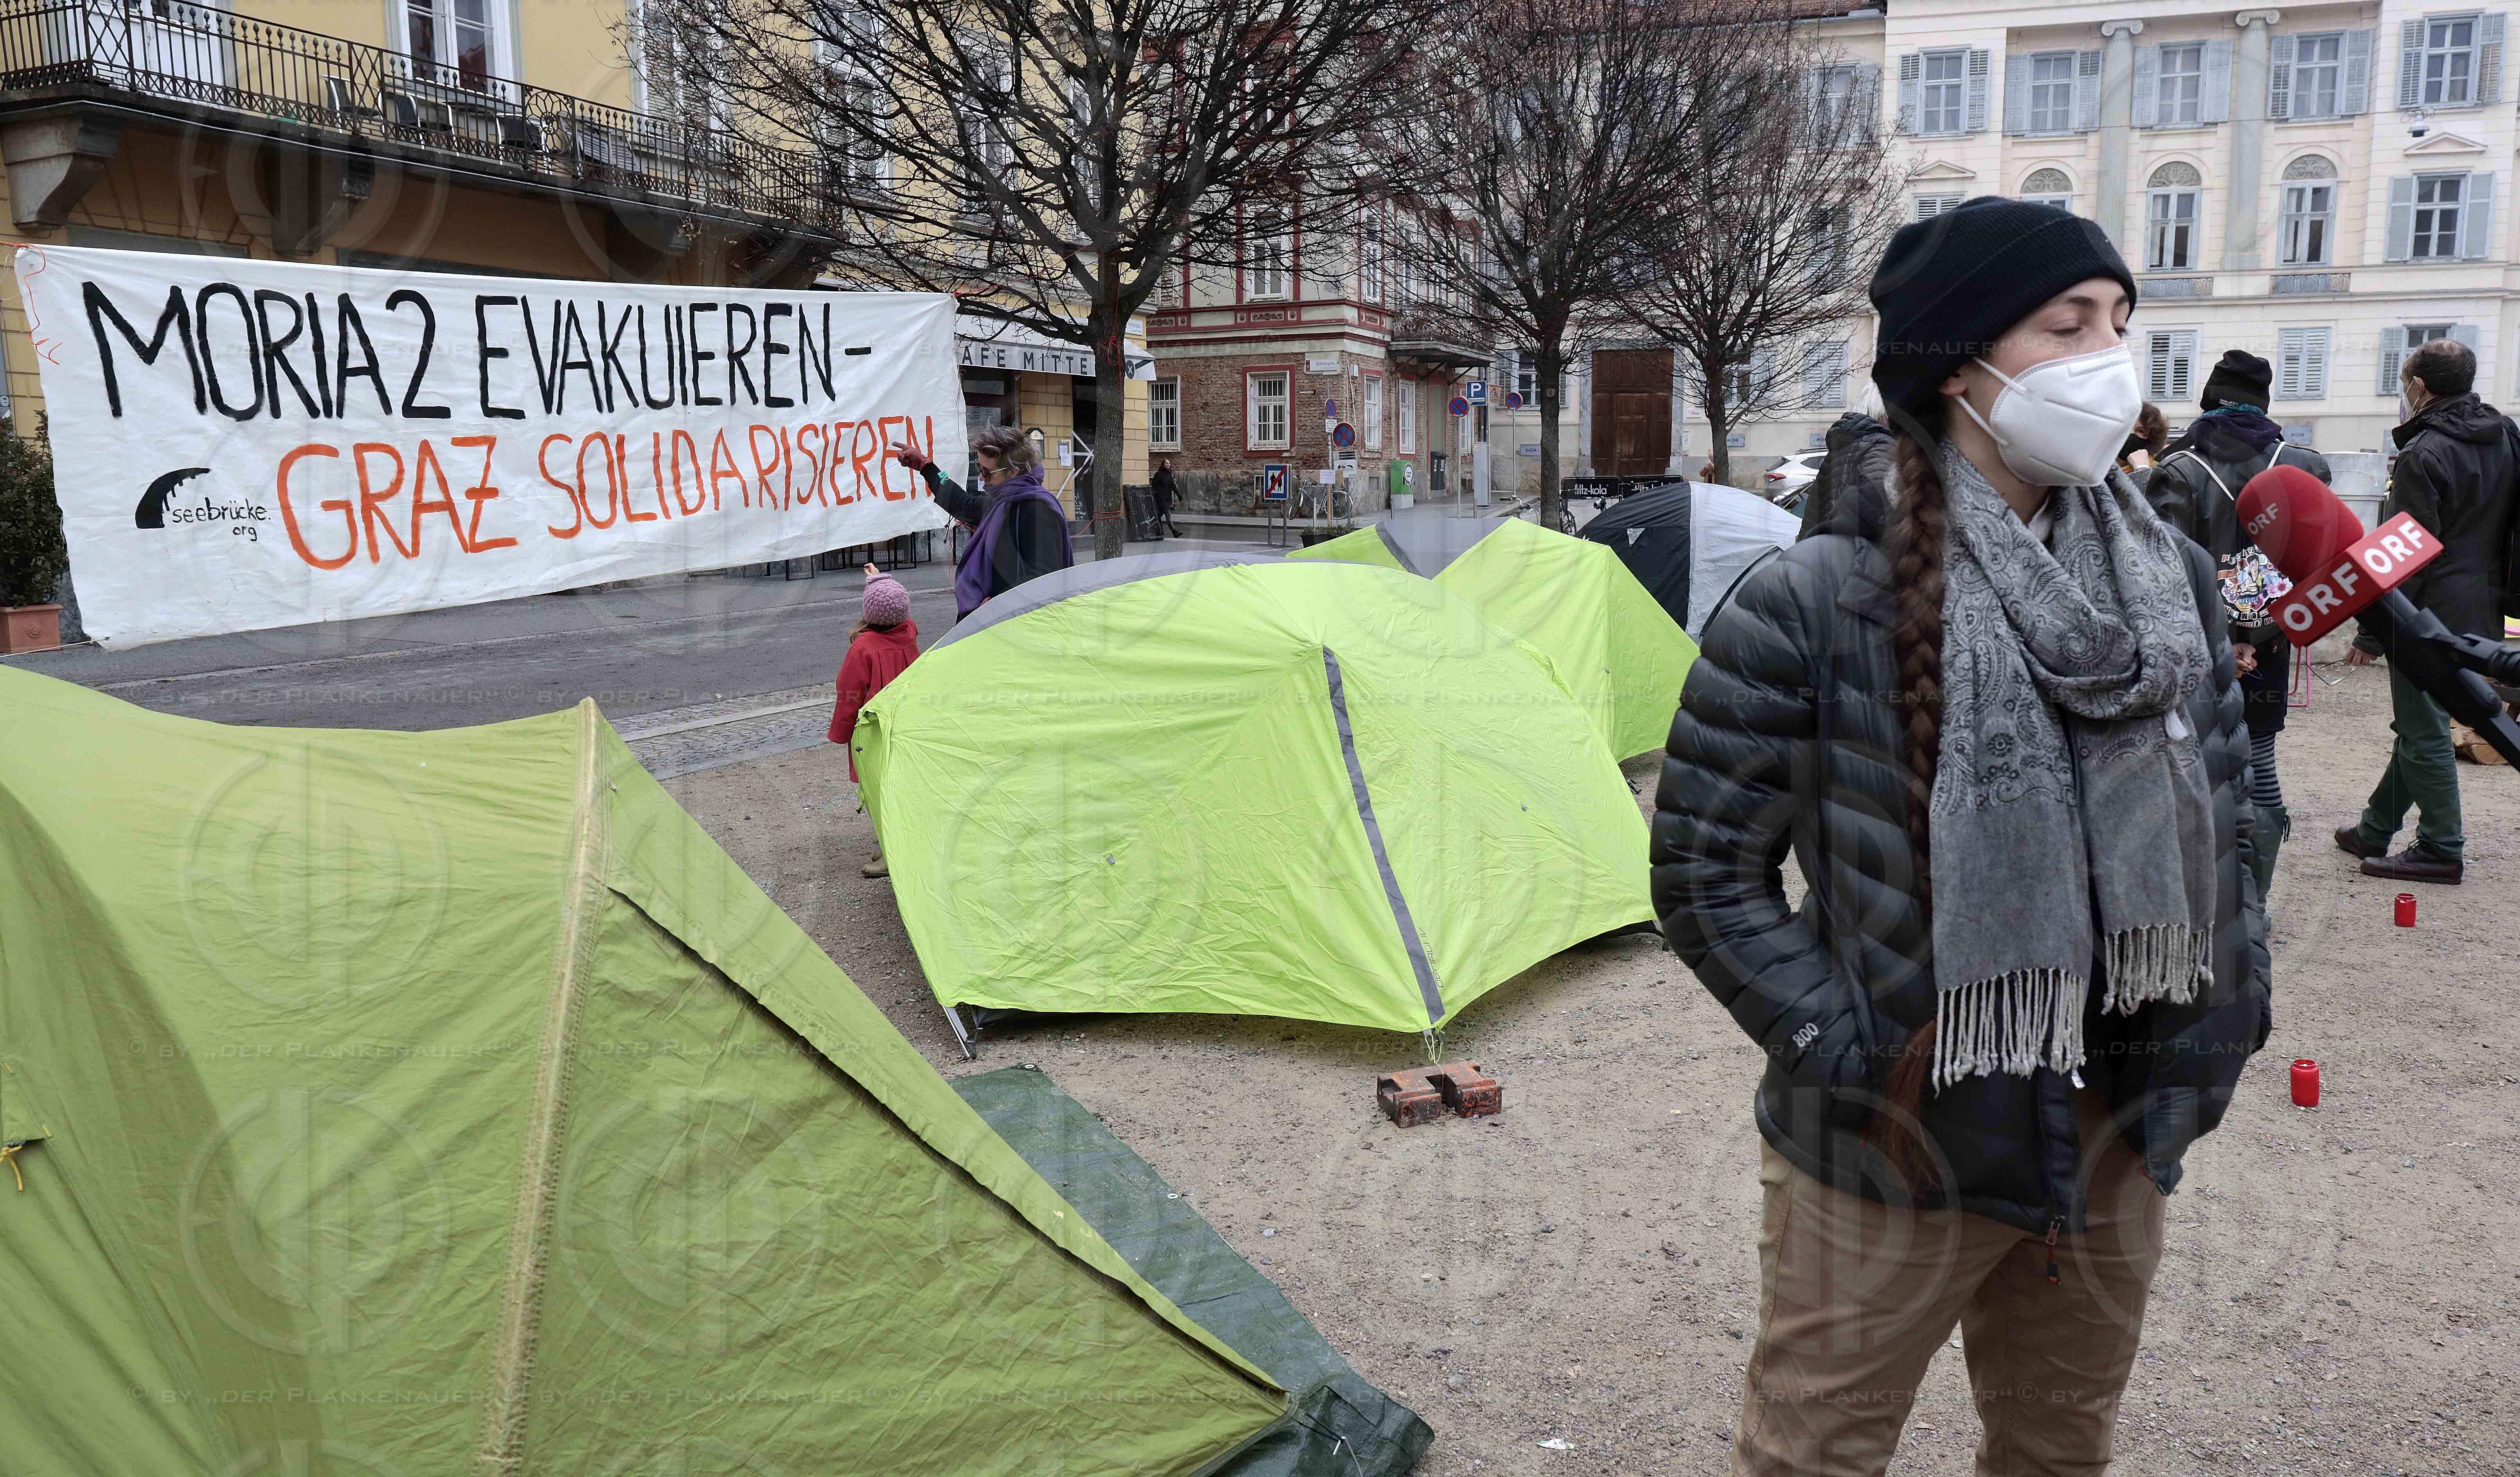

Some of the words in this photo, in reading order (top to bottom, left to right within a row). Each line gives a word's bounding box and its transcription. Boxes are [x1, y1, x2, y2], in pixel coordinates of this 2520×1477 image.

[962, 346, 1006, 368] AFE
[1023, 351, 1088, 375] MITTE
[1471, 383, 1482, 397] P
[278, 435, 519, 571] GRAZ
[538, 415, 933, 539] SOLIDARISIEREN
[232, 526, 257, 542] org
[2247, 502, 2280, 535] ORF
[2364, 520, 2425, 574] ORF
[2282, 562, 2359, 632] ORF
[1791, 1022, 1819, 1048] 800
